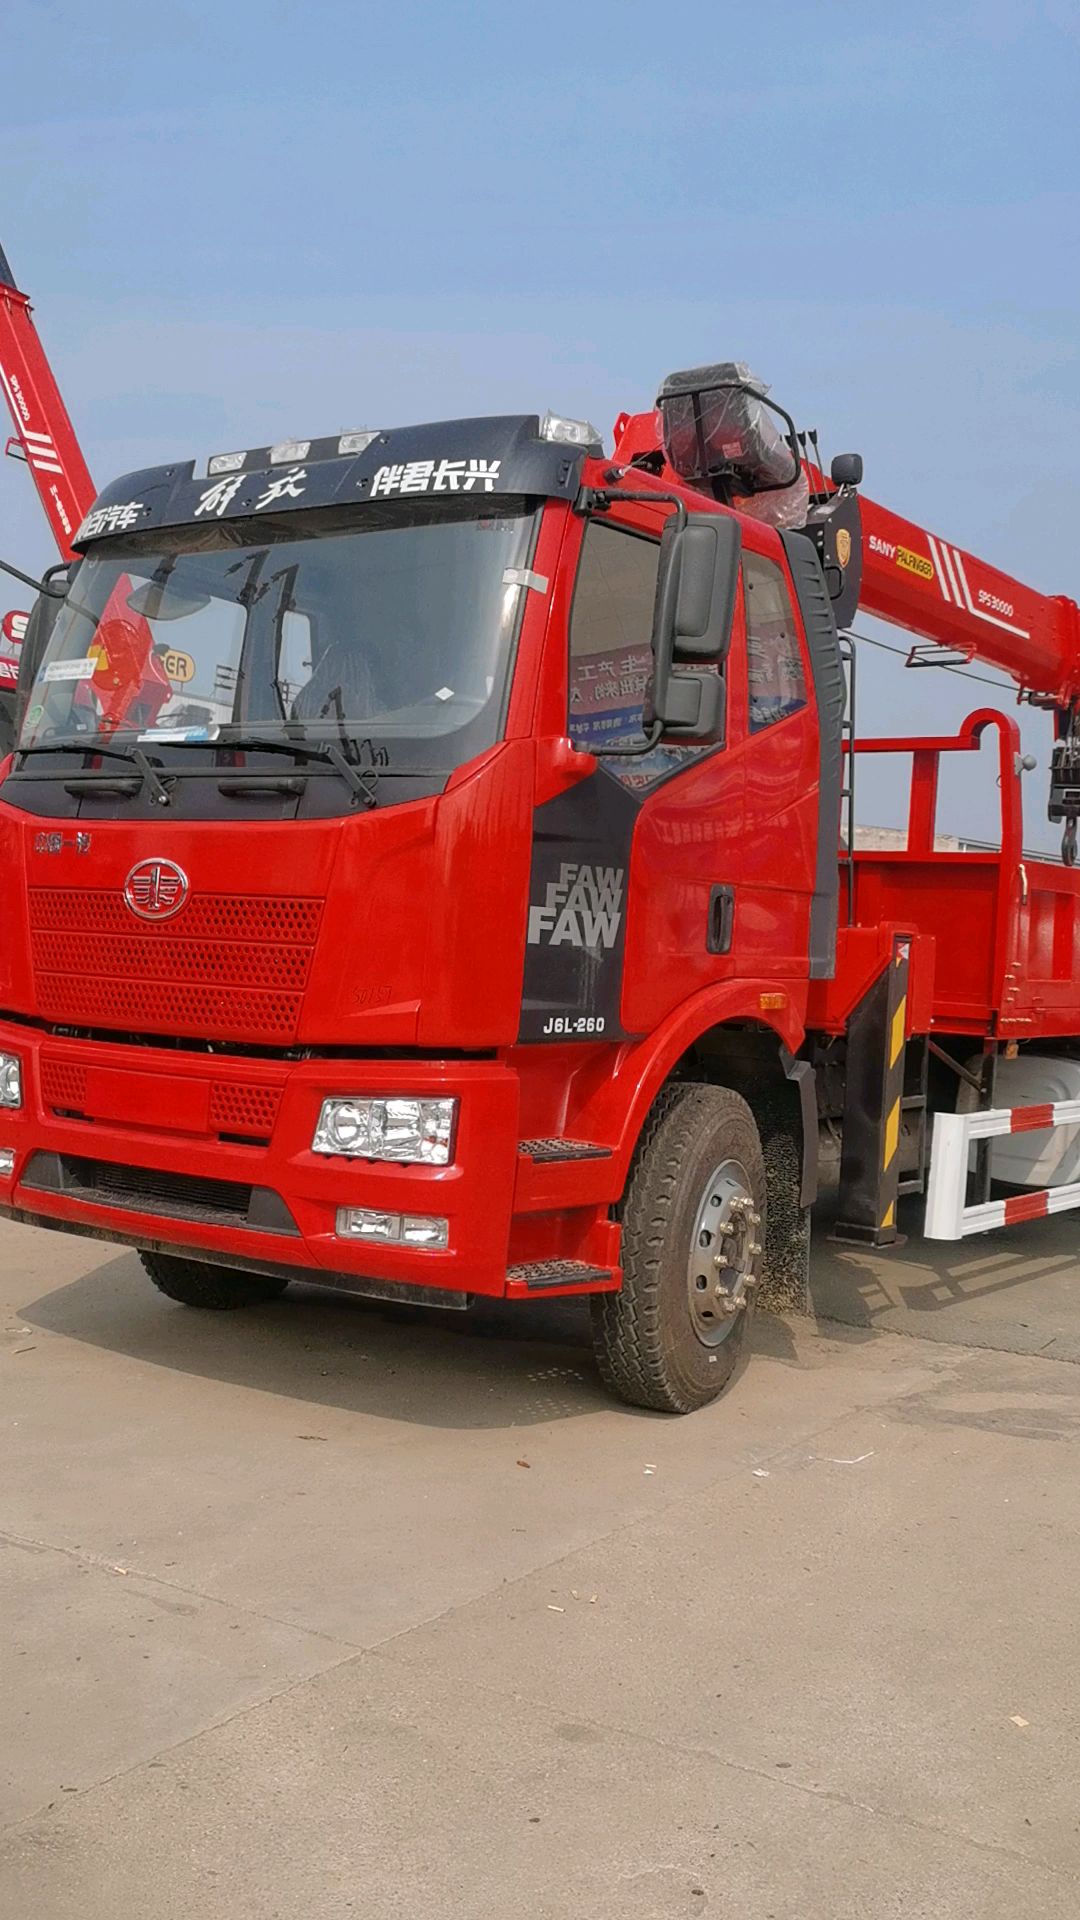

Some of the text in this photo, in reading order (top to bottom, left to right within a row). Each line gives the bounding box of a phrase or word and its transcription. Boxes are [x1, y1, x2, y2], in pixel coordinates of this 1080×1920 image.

[370, 459, 501, 497] 伴君长兴
[869, 535, 896, 559] SANY
[978, 589, 1014, 618] SPS30000
[161, 655, 187, 678] ER
[560, 862, 624, 892] FAW
[545, 882, 623, 919] FAW
[527, 905, 622, 949] FAW
[543, 1017, 605, 1034] J6L-260
